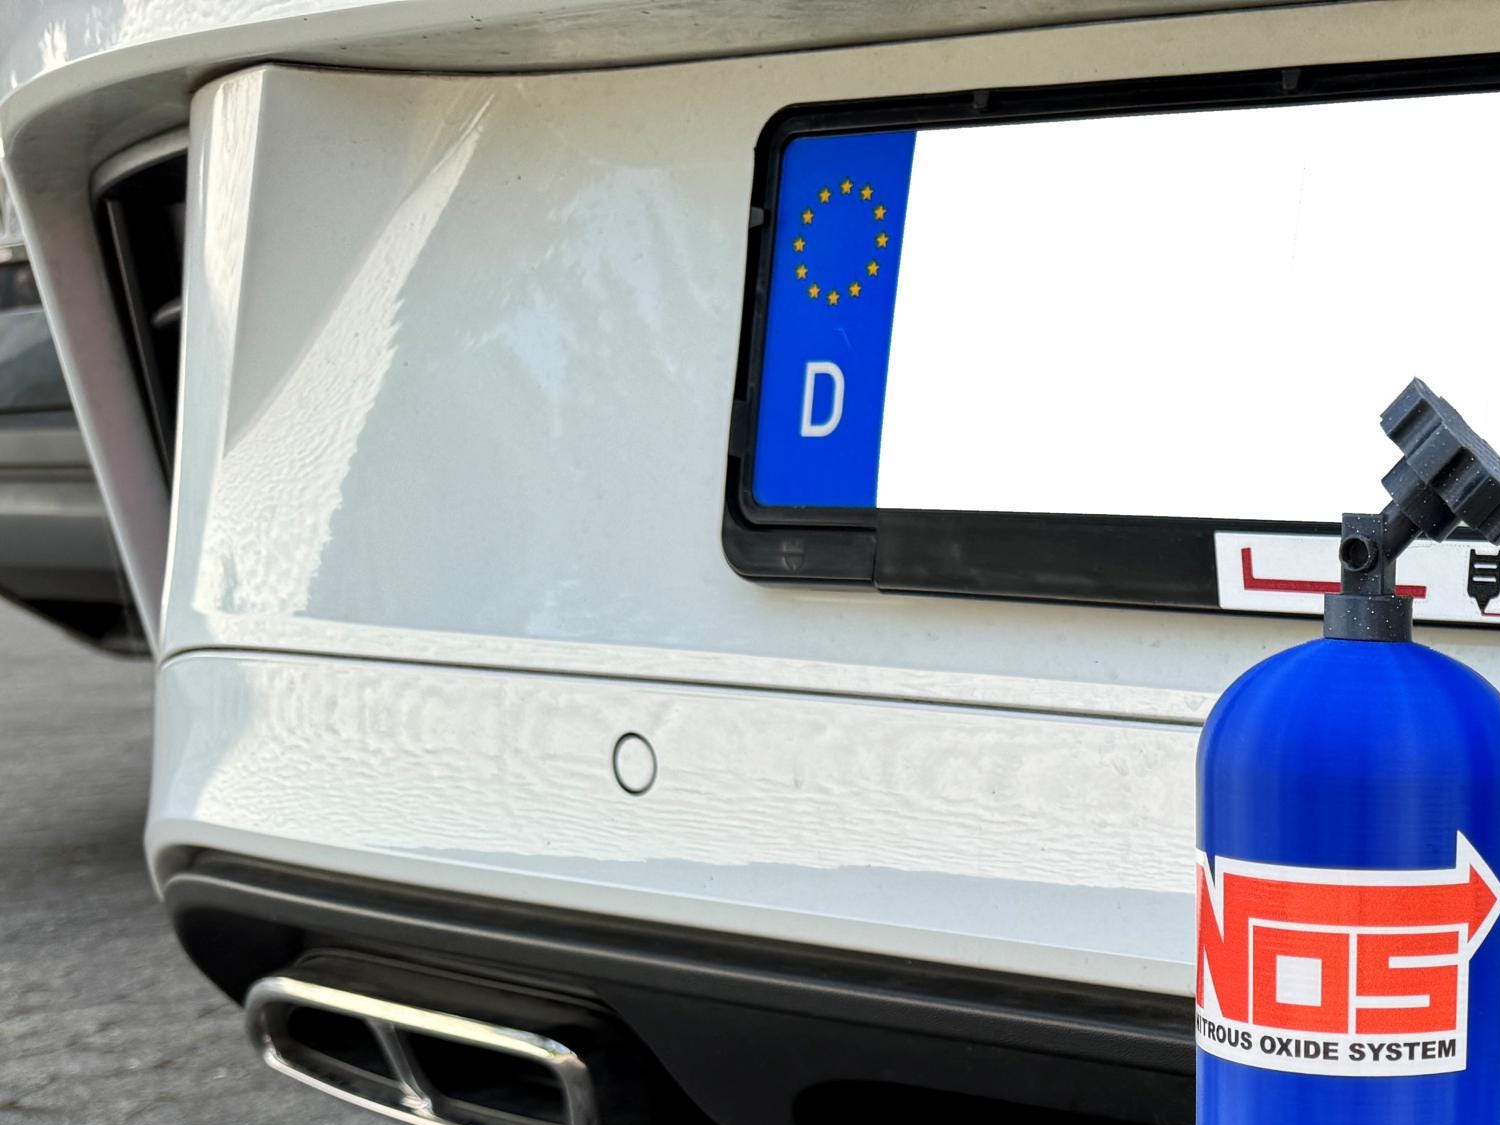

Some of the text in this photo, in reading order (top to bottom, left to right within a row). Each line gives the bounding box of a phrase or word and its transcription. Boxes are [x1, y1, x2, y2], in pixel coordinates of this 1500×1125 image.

[801, 362, 845, 437] D
[1196, 862, 1498, 1034] NOS
[1260, 1035, 1339, 1061] OXIDE
[1348, 1039, 1457, 1062] SYSTEM
